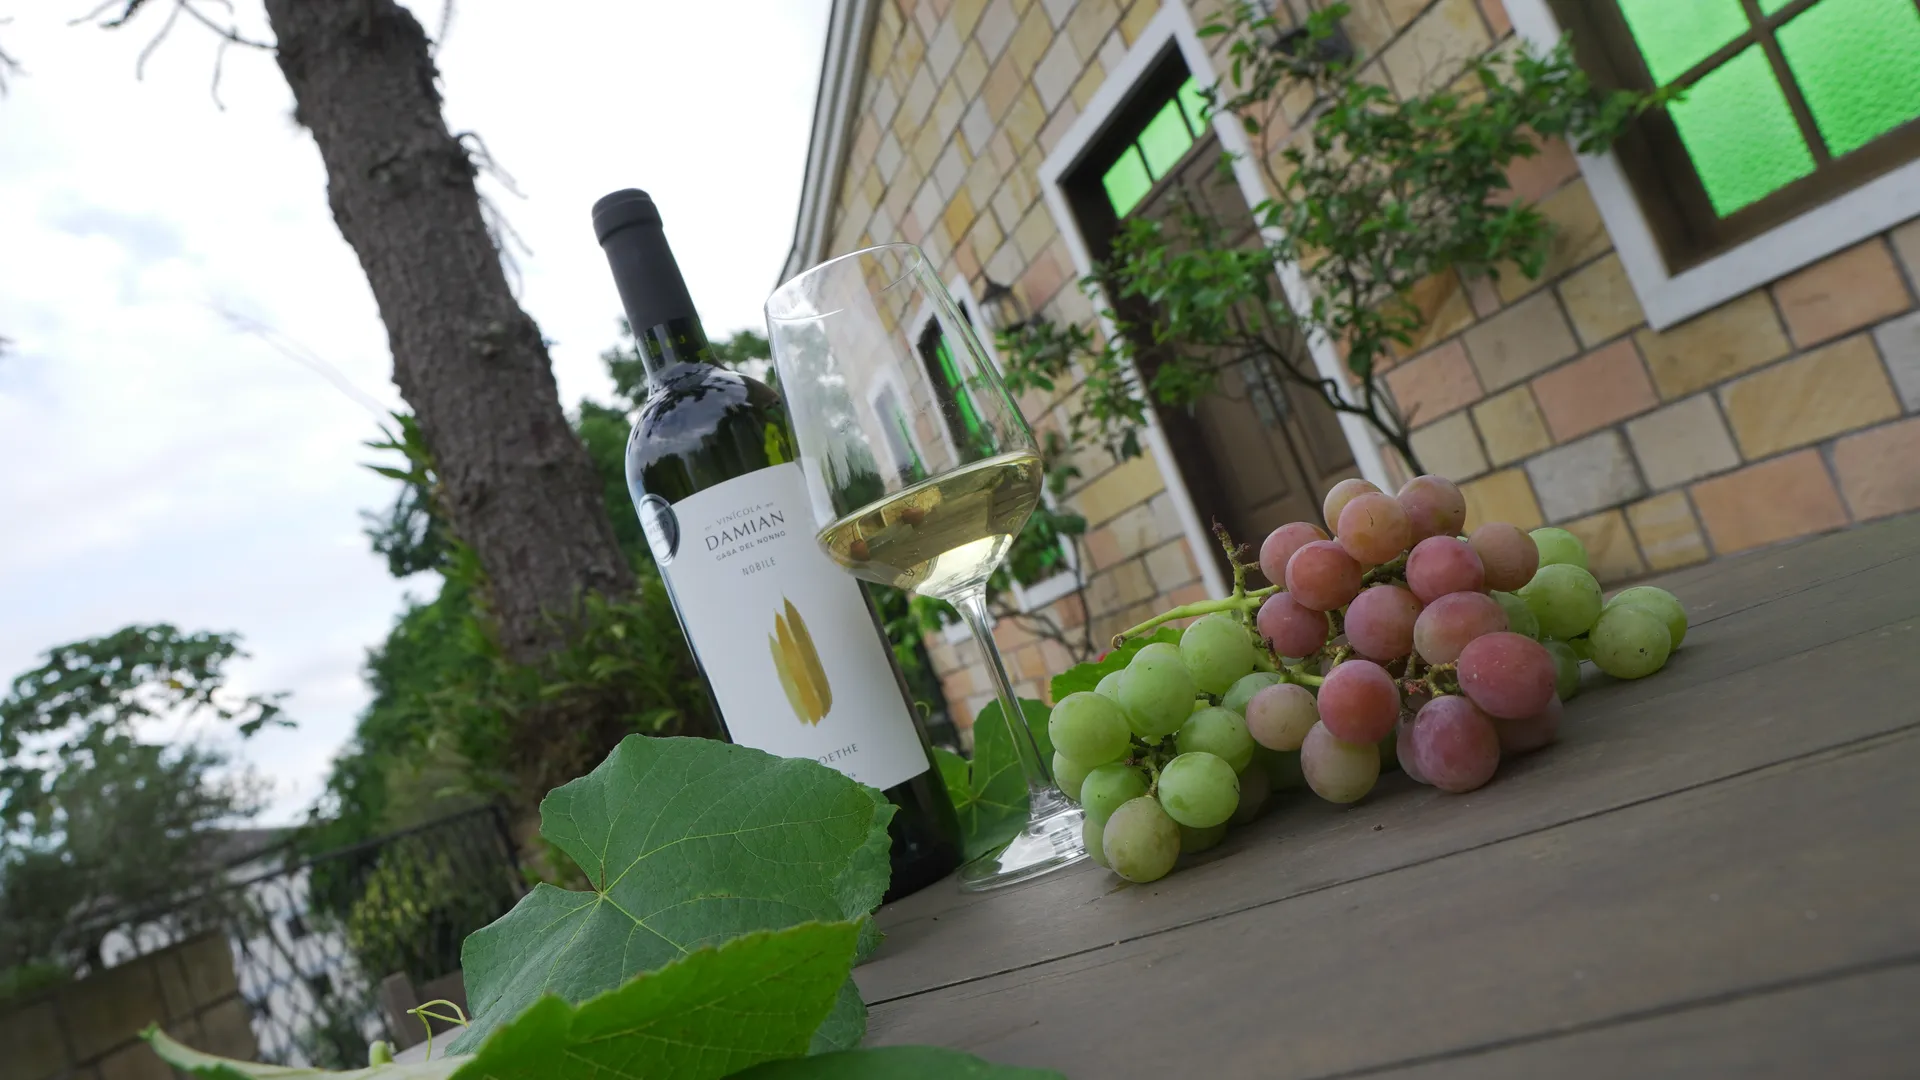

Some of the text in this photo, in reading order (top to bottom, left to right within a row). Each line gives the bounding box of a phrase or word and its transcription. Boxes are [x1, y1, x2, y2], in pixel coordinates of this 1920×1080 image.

[705, 510, 785, 551] DAMIAN
[716, 530, 786, 561] CASA DEL NONNO
[742, 556, 776, 576] NOBILE
[818, 743, 858, 765] OETHE
